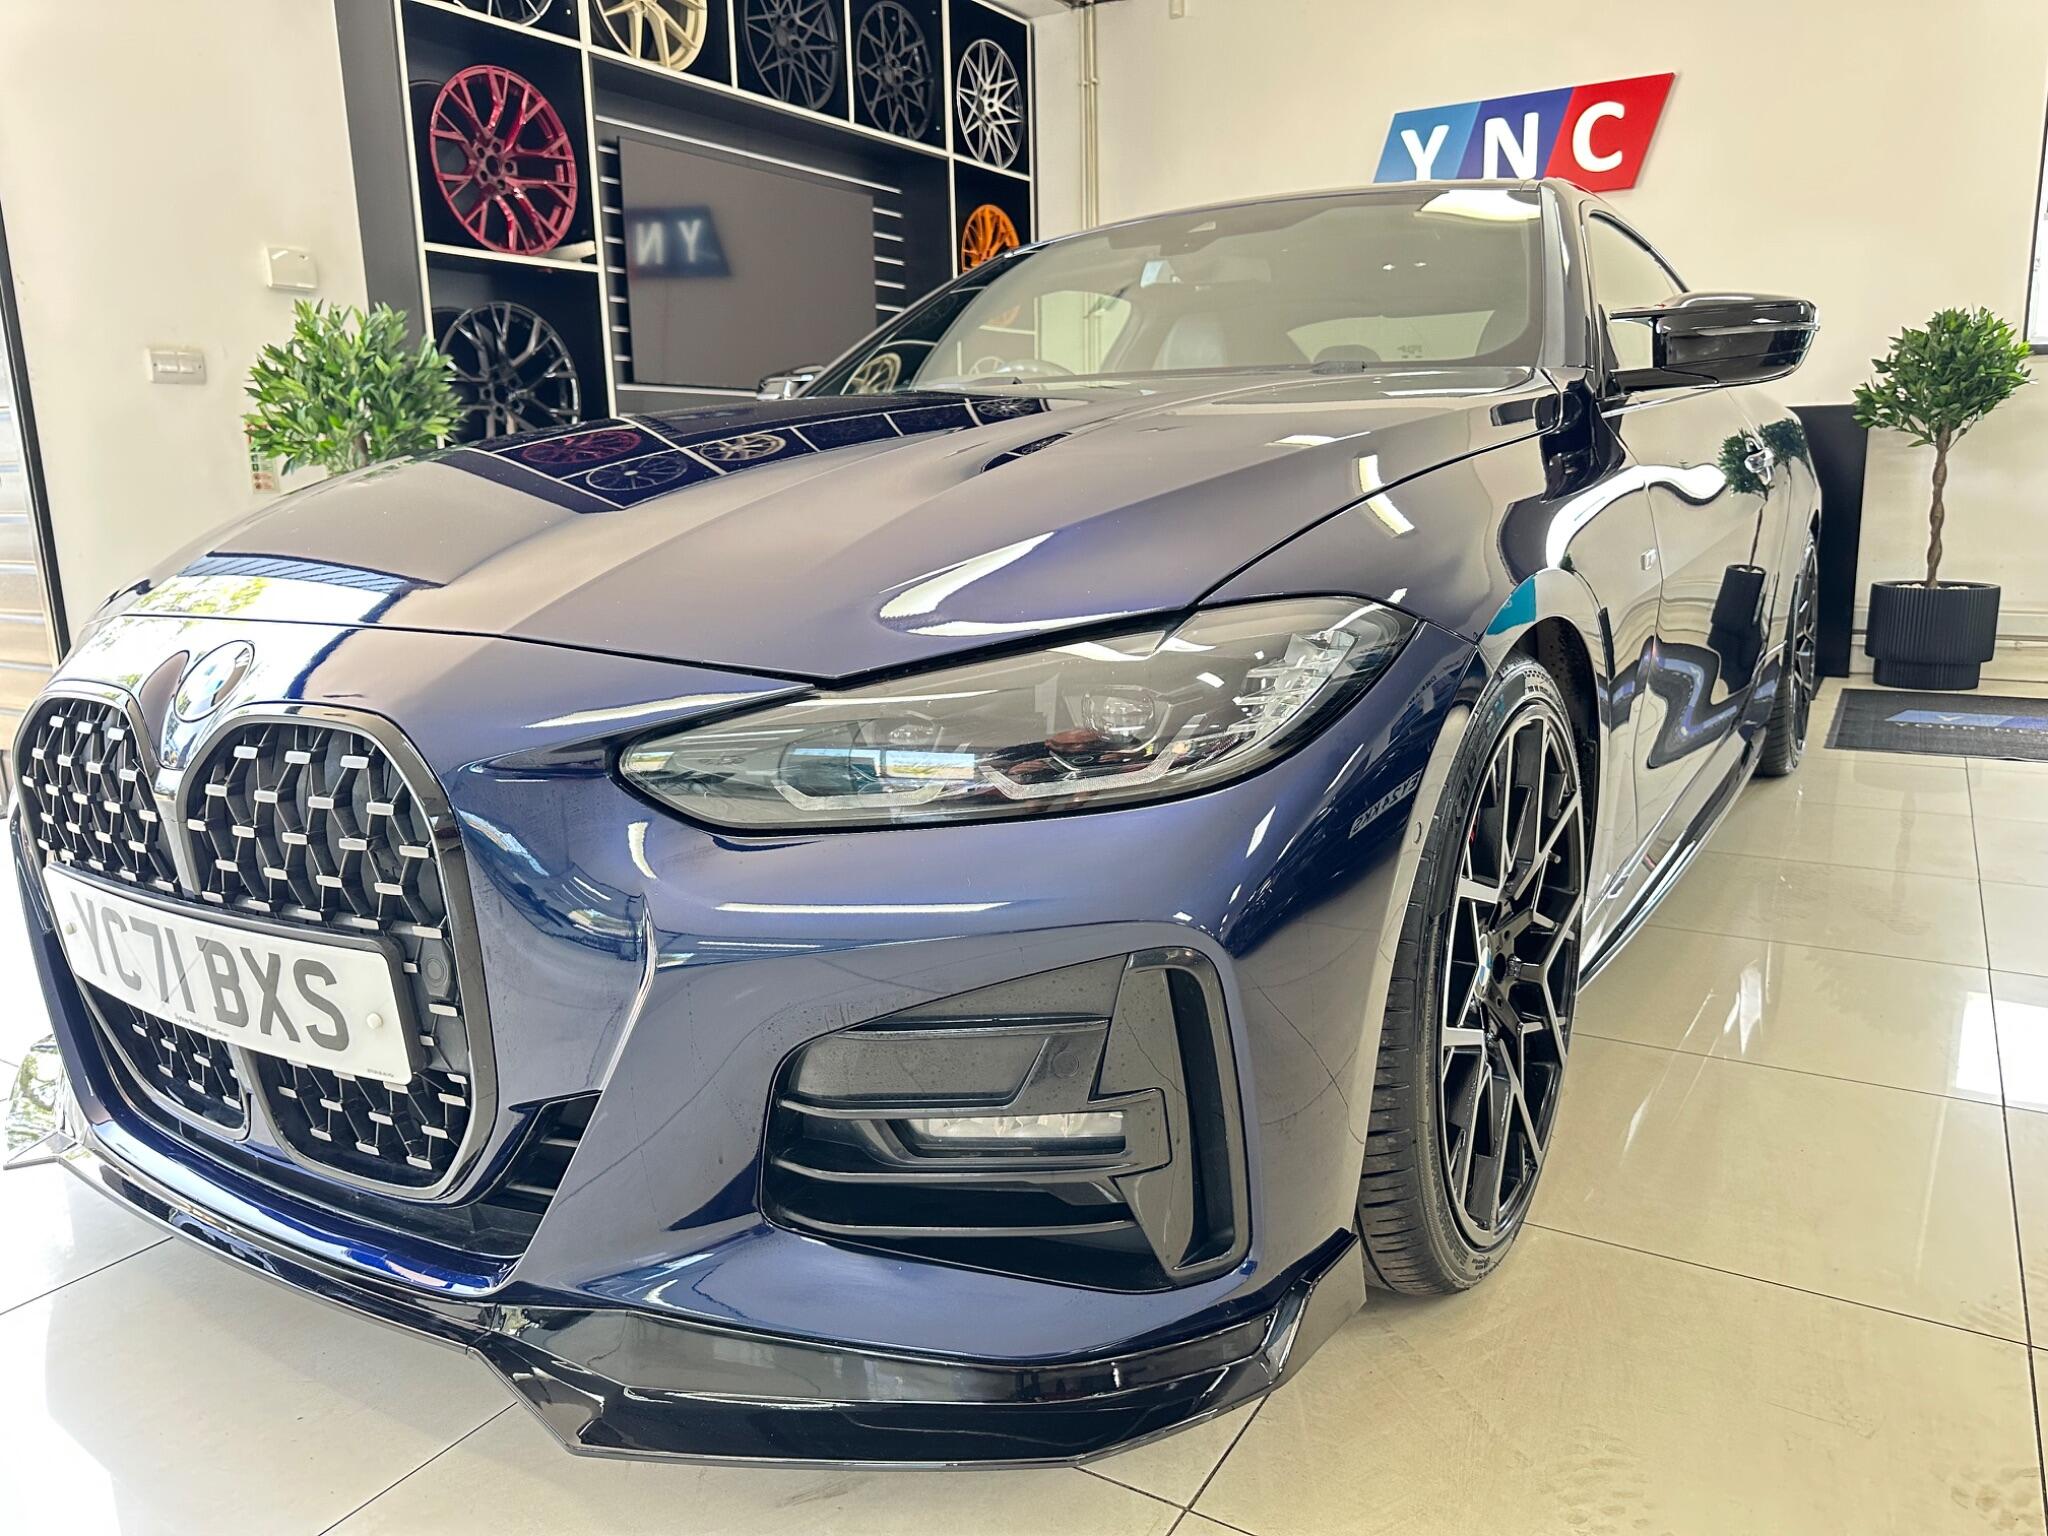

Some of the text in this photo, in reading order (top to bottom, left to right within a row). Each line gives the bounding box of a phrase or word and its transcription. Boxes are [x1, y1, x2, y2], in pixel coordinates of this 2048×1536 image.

[1401, 101, 1625, 180] YNC
[70, 891, 350, 1052] YC71 BXS
